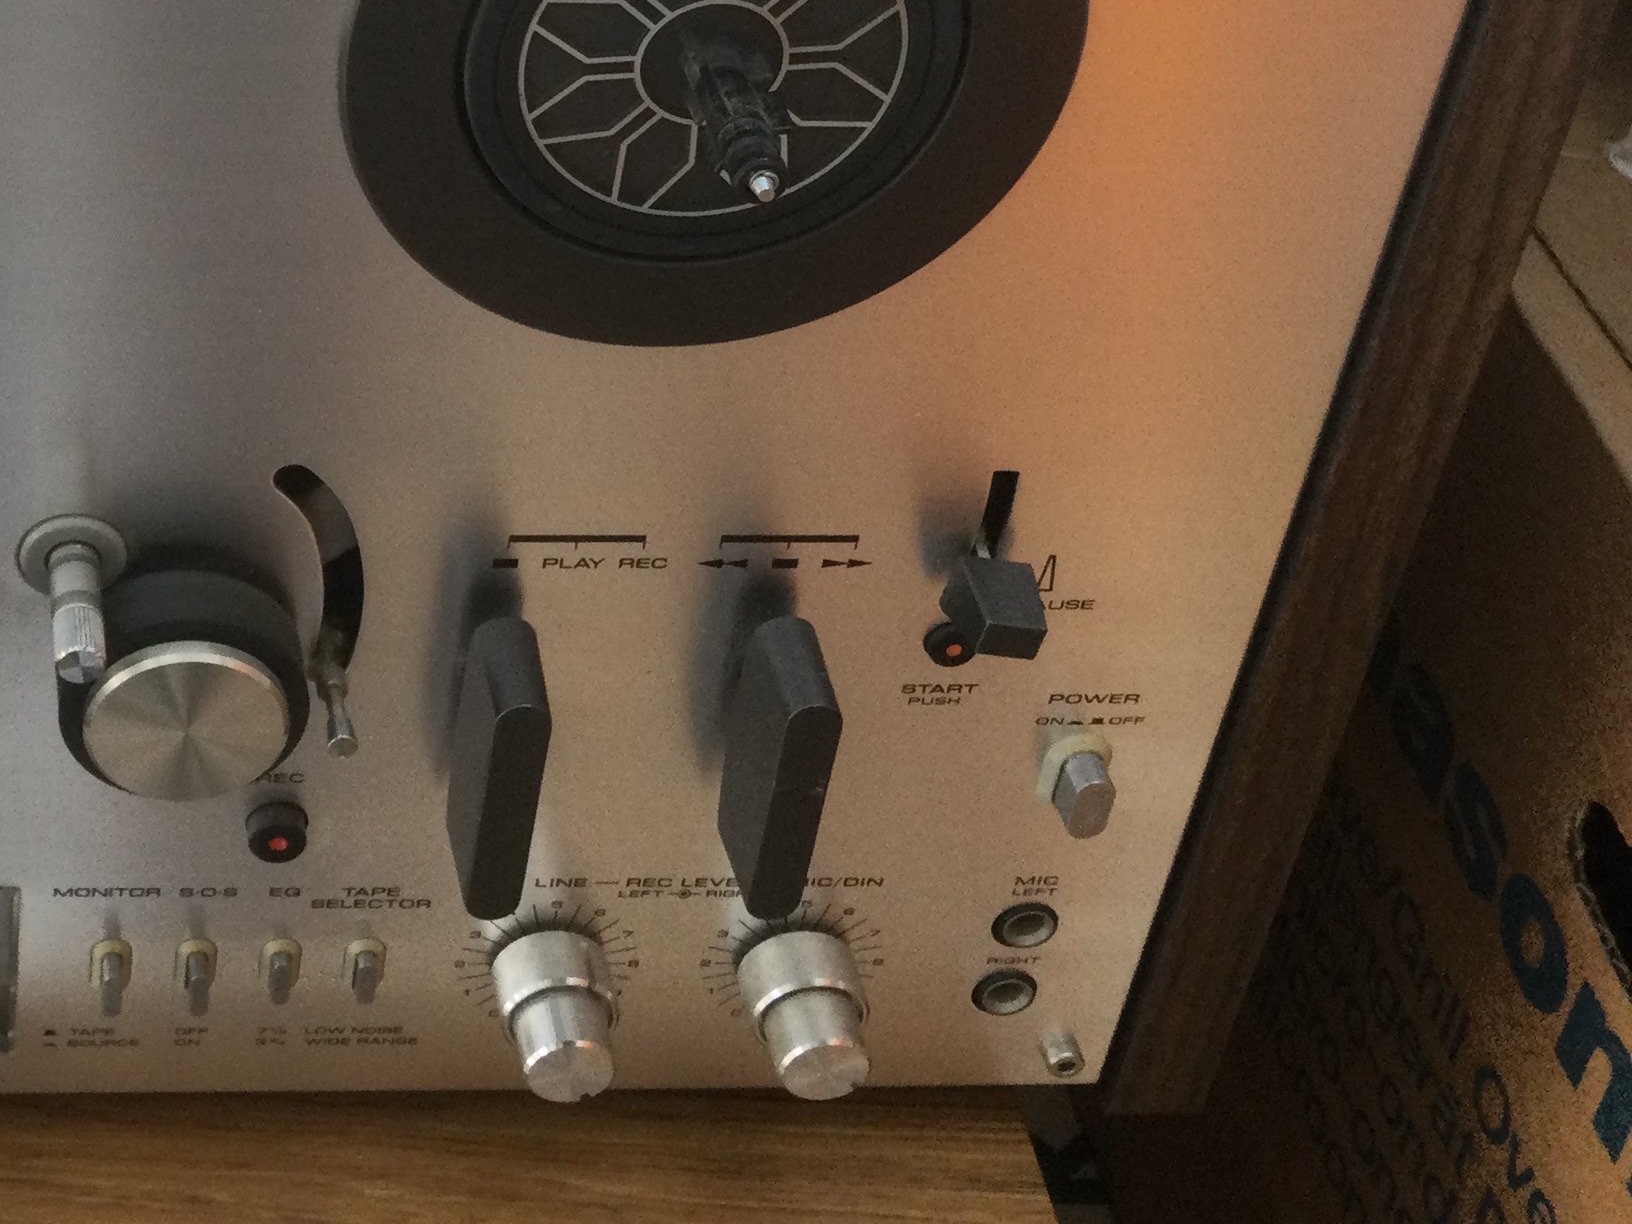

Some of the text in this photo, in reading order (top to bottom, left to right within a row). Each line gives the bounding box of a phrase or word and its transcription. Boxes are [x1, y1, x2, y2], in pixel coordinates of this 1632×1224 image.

[542, 558, 667, 569] PLAY REC
[1043, 599, 1095, 611] USE
[901, 683, 979, 694] START
[907, 696, 961, 705] PUSH
[1048, 693, 1141, 705] POWER
[1034, 717, 1064, 725] ON
[1108, 717, 1145, 725] OFF
[534, 877, 884, 888] LINE REC LEVE IC/DIN
[1014, 876, 1059, 886] MIC
[53, 888, 161, 898] MONITOR
[269, 888, 301, 898] EQ
[342, 887, 401, 897] TAPE
[618, 890, 666, 898] LEFT
[1011, 887, 1058, 896] LEFT
[311, 898, 431, 909] SELECTOR
[986, 957, 1041, 965] RIGHT
[305, 1026, 346, 1034] LOW
[305, 1037, 418, 1046] WIDE RANGE
